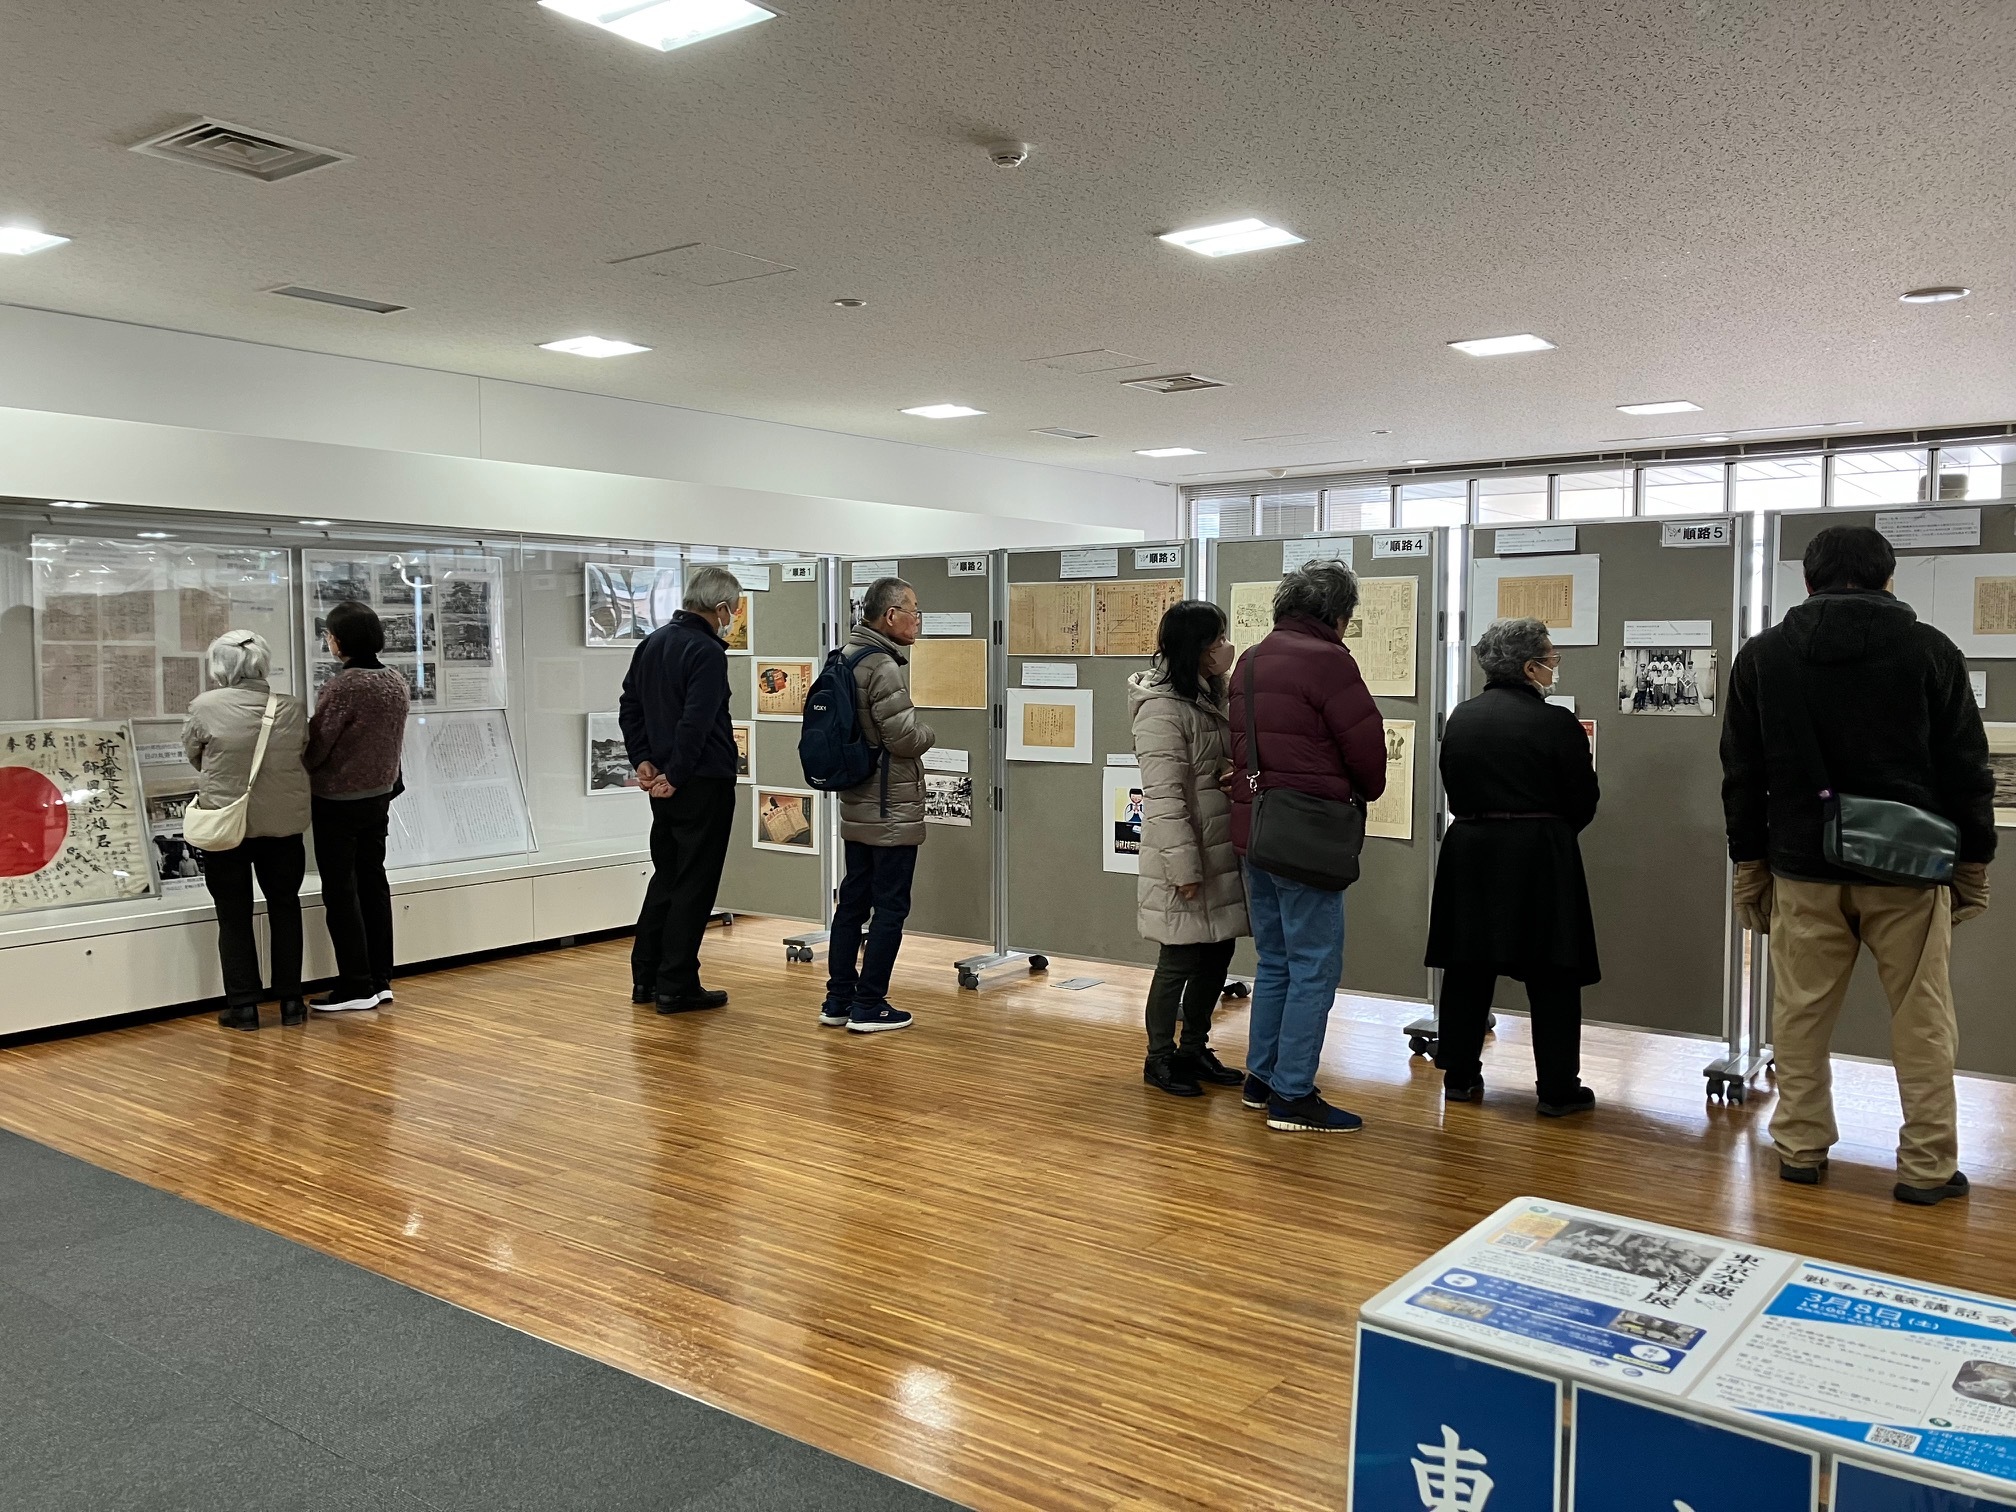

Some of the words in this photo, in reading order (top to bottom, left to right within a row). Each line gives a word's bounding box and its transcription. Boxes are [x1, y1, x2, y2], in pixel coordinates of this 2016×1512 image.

[1683, 526, 1723, 541] 順路5
[1389, 539, 1423, 552] 順路4
[1149, 552, 1176, 564] 順路3
[792, 566, 811, 577] 順路1
[959, 561, 982, 572] 順路2
[1802, 1274, 2014, 1327] 戦争体験講話会
